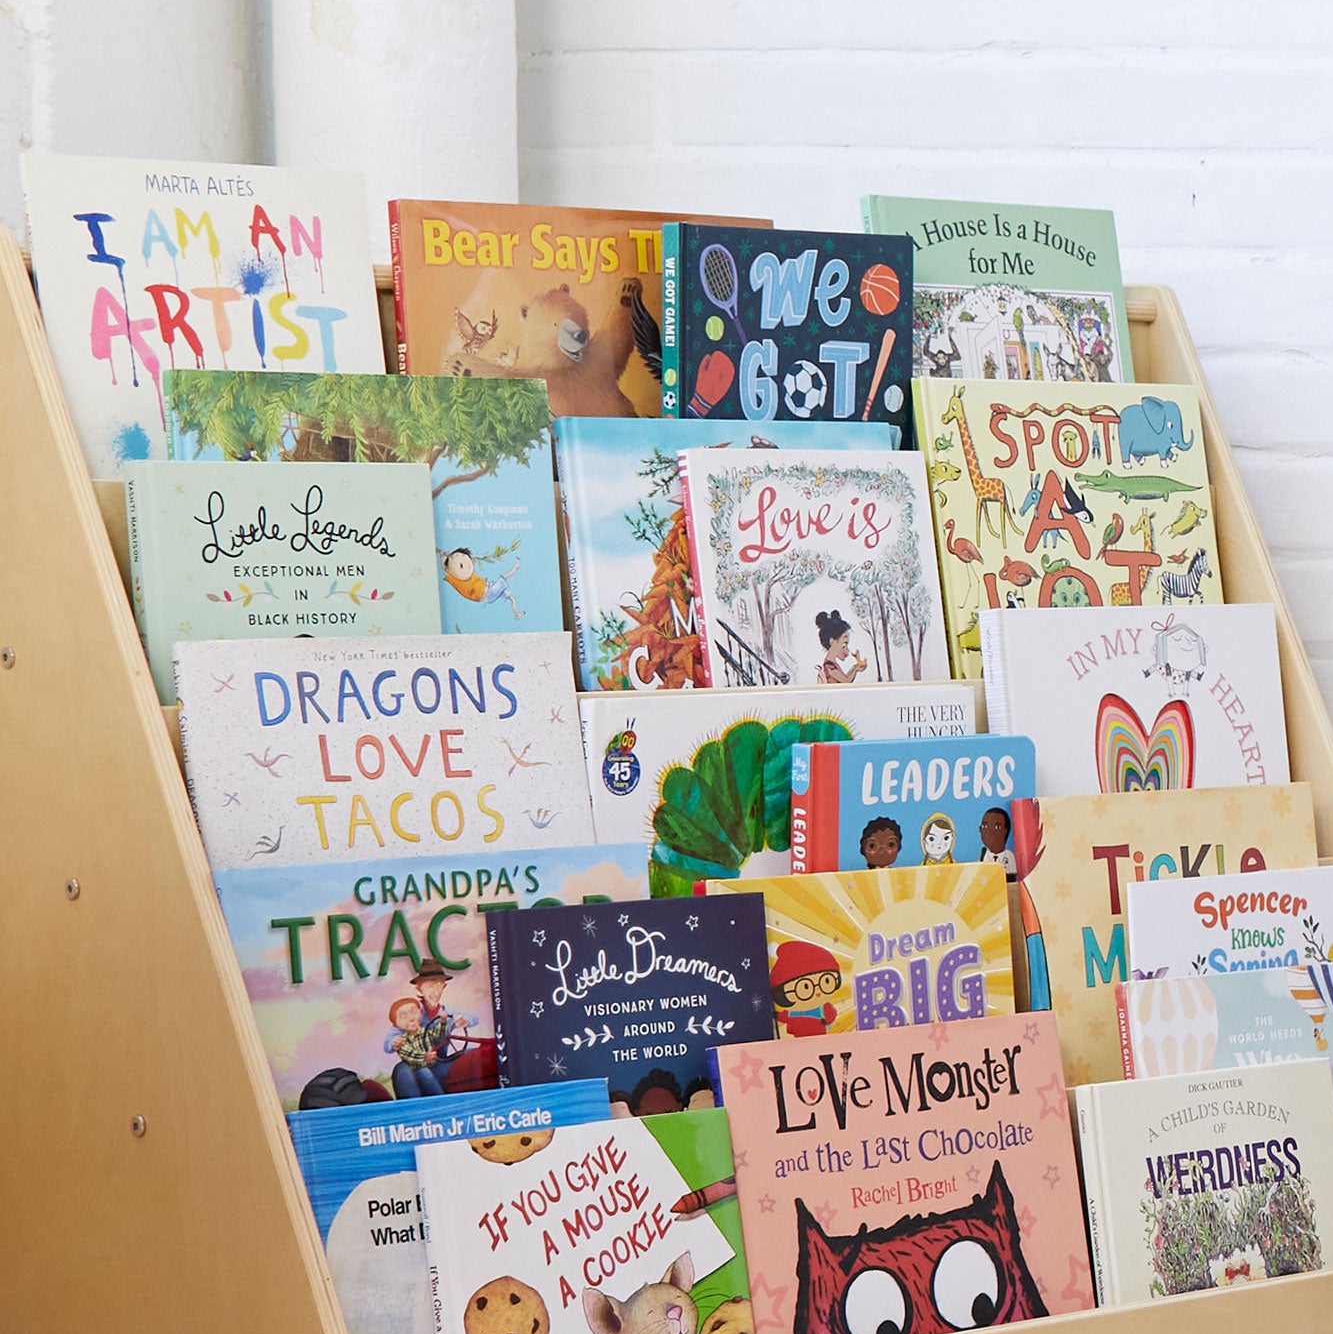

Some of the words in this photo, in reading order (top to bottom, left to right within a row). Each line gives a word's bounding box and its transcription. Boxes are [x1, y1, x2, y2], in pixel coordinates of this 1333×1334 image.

[145, 174, 200, 195] MARTA
[207, 175, 254, 197] ALTÉS
[142, 207, 220, 264] AM
[249, 204, 323, 269] AN
[391, 223, 400, 253] Wilson
[421, 218, 519, 268] Bear
[531, 224, 619, 283] Says
[921, 217, 988, 246] House
[993, 213, 1011, 238] Is
[1017, 225, 1027, 240] a
[1033, 220, 1097, 267] House
[665, 257, 675, 277] WE
[968, 247, 998, 274] for
[1001, 251, 1036, 276] Me
[665, 279, 675, 305] GOT
[749, 249, 851, 330] We
[90, 283, 348, 379] ARTIST
[665, 307, 675, 347] GAME!
[989, 408, 1121, 471] SPOT
[128, 480, 136, 514] VASHTI
[448, 503, 484, 516] Timothy
[1024, 470, 1091, 560] A
[131, 516, 139, 563] HARRISON
[194, 491, 287, 563] Little
[290, 485, 396, 557] Legends
[455, 519, 481, 529] Sarah
[738, 486, 843, 563] Love
[847, 497, 892, 549] is
[234, 565, 329, 577] EXCEPTIONAL
[336, 565, 365, 576] MEN
[571, 577, 579, 602] MANY
[294, 590, 308, 601] IN
[249, 614, 289, 625] BLACK
[296, 613, 357, 624] HISTORY
[574, 604, 586, 664] CARROTS
[403, 650, 452, 660] bestseller
[255, 664, 518, 726] DRAGONS
[897, 706, 927, 723] THE
[929, 705, 966, 722] VERY
[1067, 642, 1099, 681] IN
[1100, 628, 1143, 660] MY
[1209, 674, 1266, 785] HEART
[318, 729, 472, 782] LOVE
[609, 762, 631, 781] 45
[861, 755, 1016, 806] LEADERS
[296, 784, 505, 850] TACOS
[793, 808, 806, 875] LEADE
[354, 865, 540, 906] GRANDPA'S
[1194, 891, 1308, 930] Spencer
[489, 930, 498, 962] VASHTI
[868, 922, 955, 965] Dream
[1231, 927, 1285, 950] knows
[546, 940, 623, 1006] Little
[624, 926, 743, 993] Dreamers
[493, 965, 501, 1010] HARRISON
[584, 998, 655, 1017] VISIONARY
[660, 994, 708, 1010] WOMEN
[854, 943, 986, 1031] BIG
[623, 1021, 676, 1037] AROUND
[1119, 1008, 1128, 1045] JOANNA
[1228, 1032, 1265, 1044] WORLD
[1270, 1027, 1302, 1040] NEEDS
[1254, 1015, 1273, 1027] THE
[612, 1049, 638, 1062] THE
[643, 1043, 688, 1059] WORLD
[1123, 1048, 1132, 1080] GAINE
[878, 1044, 1021, 1117] Monster
[1188, 1082, 1208, 1093] DICK
[1208, 1079, 1243, 1091] GAUTIER
[358, 1126, 386, 1147] Bill
[389, 1122, 444, 1143] Martin
[447, 1118, 464, 1136] Jr
[474, 1112, 506, 1133] Eric
[508, 1107, 552, 1128] Carle
[1147, 1127, 1159, 1143] A
[1160, 1103, 1220, 1132] CHILD'S
[1223, 1100, 1290, 1124] GARDEN
[1213, 1123, 1227, 1134] OF
[775, 1150, 809, 1178] and
[817, 1142, 854, 1174] the
[861, 1136, 911, 1170] Last
[918, 1120, 1033, 1161] Chocolate
[1146, 1137, 1301, 1199] WEIRDNESS
[367, 1197, 411, 1218] Polar
[478, 1203, 509, 1252] IF
[511, 1170, 561, 1226] YOU
[565, 1136, 627, 1192] GIVE
[851, 1181, 902, 1209] Rachel
[905, 1175, 958, 1203] Bright
[370, 1224, 416, 1247] What
[543, 1230, 559, 1265] A
[562, 1173, 650, 1248] MOUSE
[430, 1265, 437, 1276] If
[559, 1275, 577, 1308] A
[583, 1203, 673, 1288] COOKIE
[431, 1276, 439, 1297] You
[433, 1299, 442, 1324] Give
